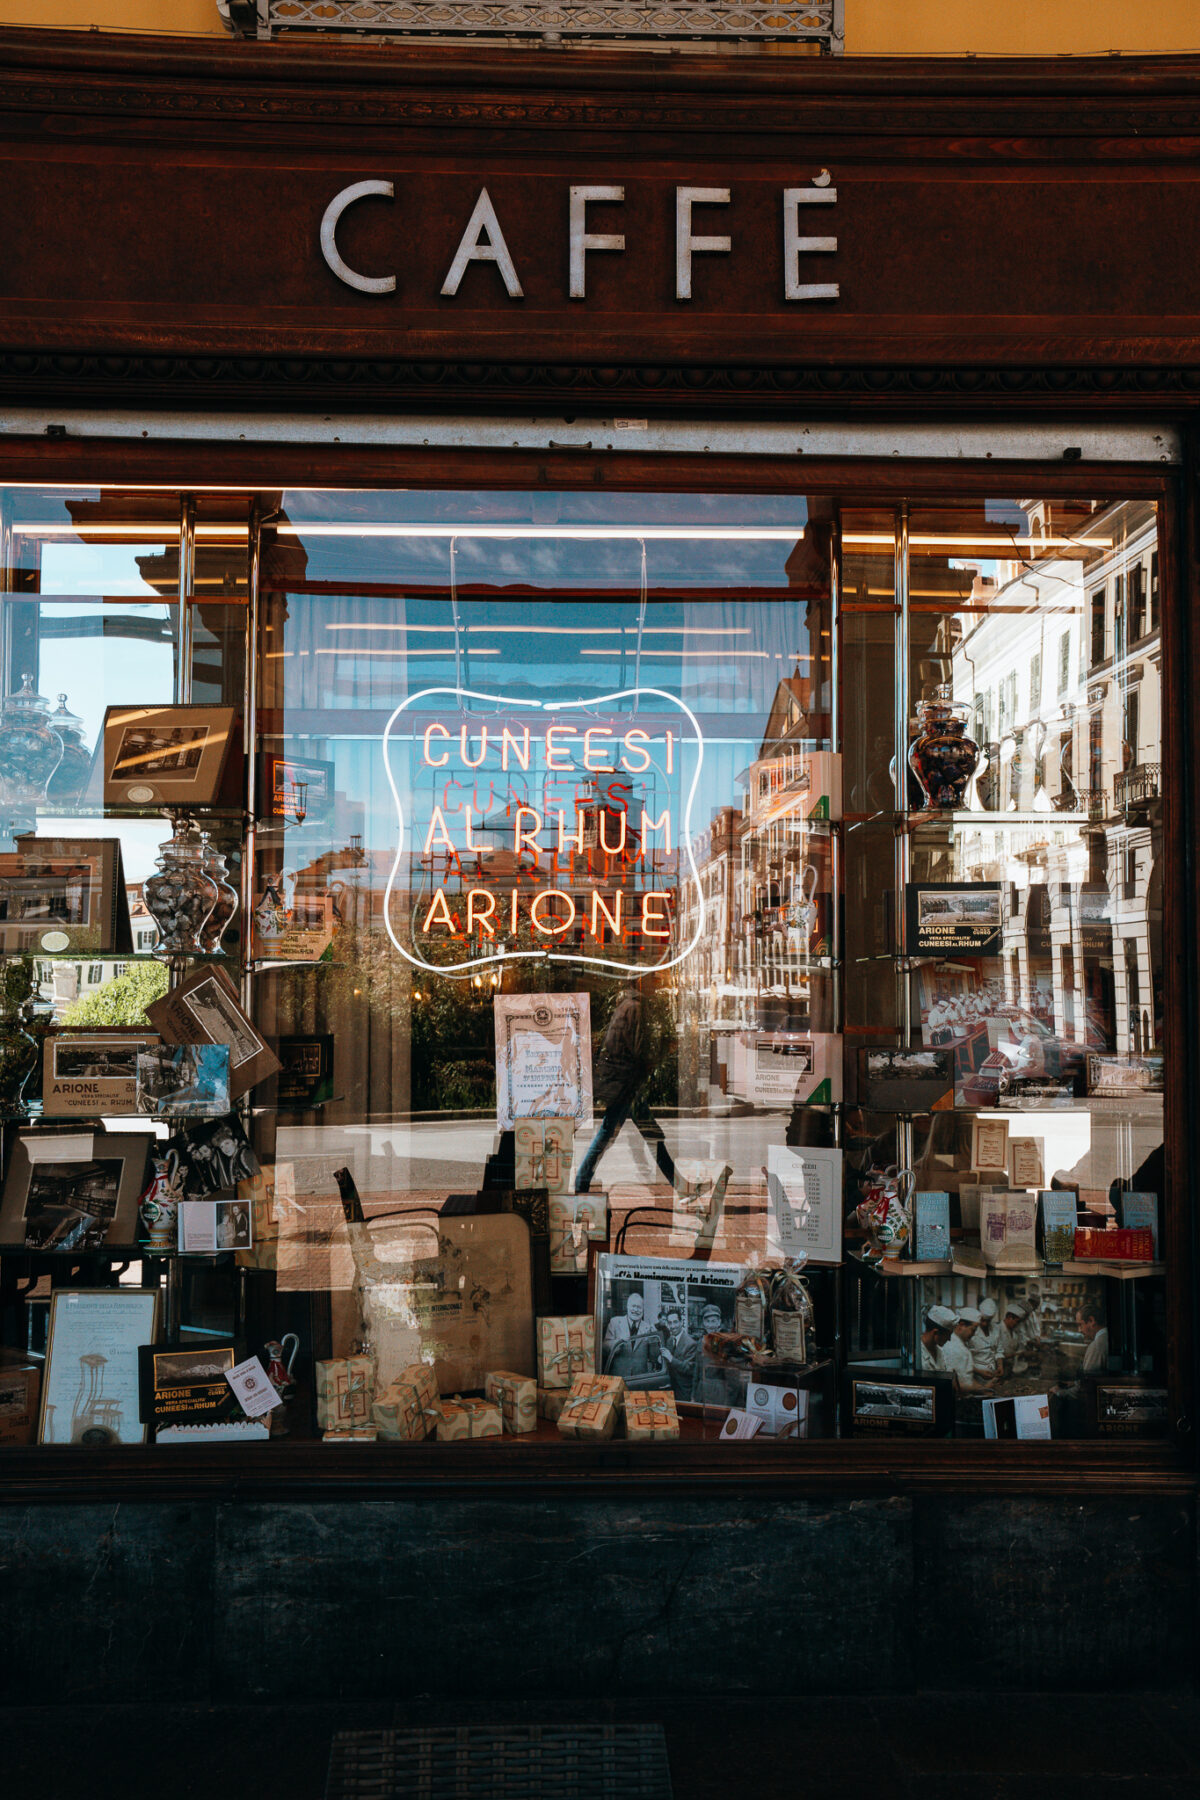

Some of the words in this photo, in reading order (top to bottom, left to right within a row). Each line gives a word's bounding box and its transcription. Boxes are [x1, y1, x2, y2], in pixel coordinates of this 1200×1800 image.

[423, 723, 674, 774] CUNEESI
[424, 805, 494, 855] AL
[515, 807, 672, 855] RHUM
[422, 887, 672, 937] ARIONE
[918, 927, 956, 935] ARIONE
[52, 1083, 99, 1094] ARIONE
[687, 1273, 699, 1284] da
[154, 1389, 192, 1401] ARIONE
[154, 1403, 188, 1414] CUNEESI
[193, 1401, 217, 1410] RHUM
